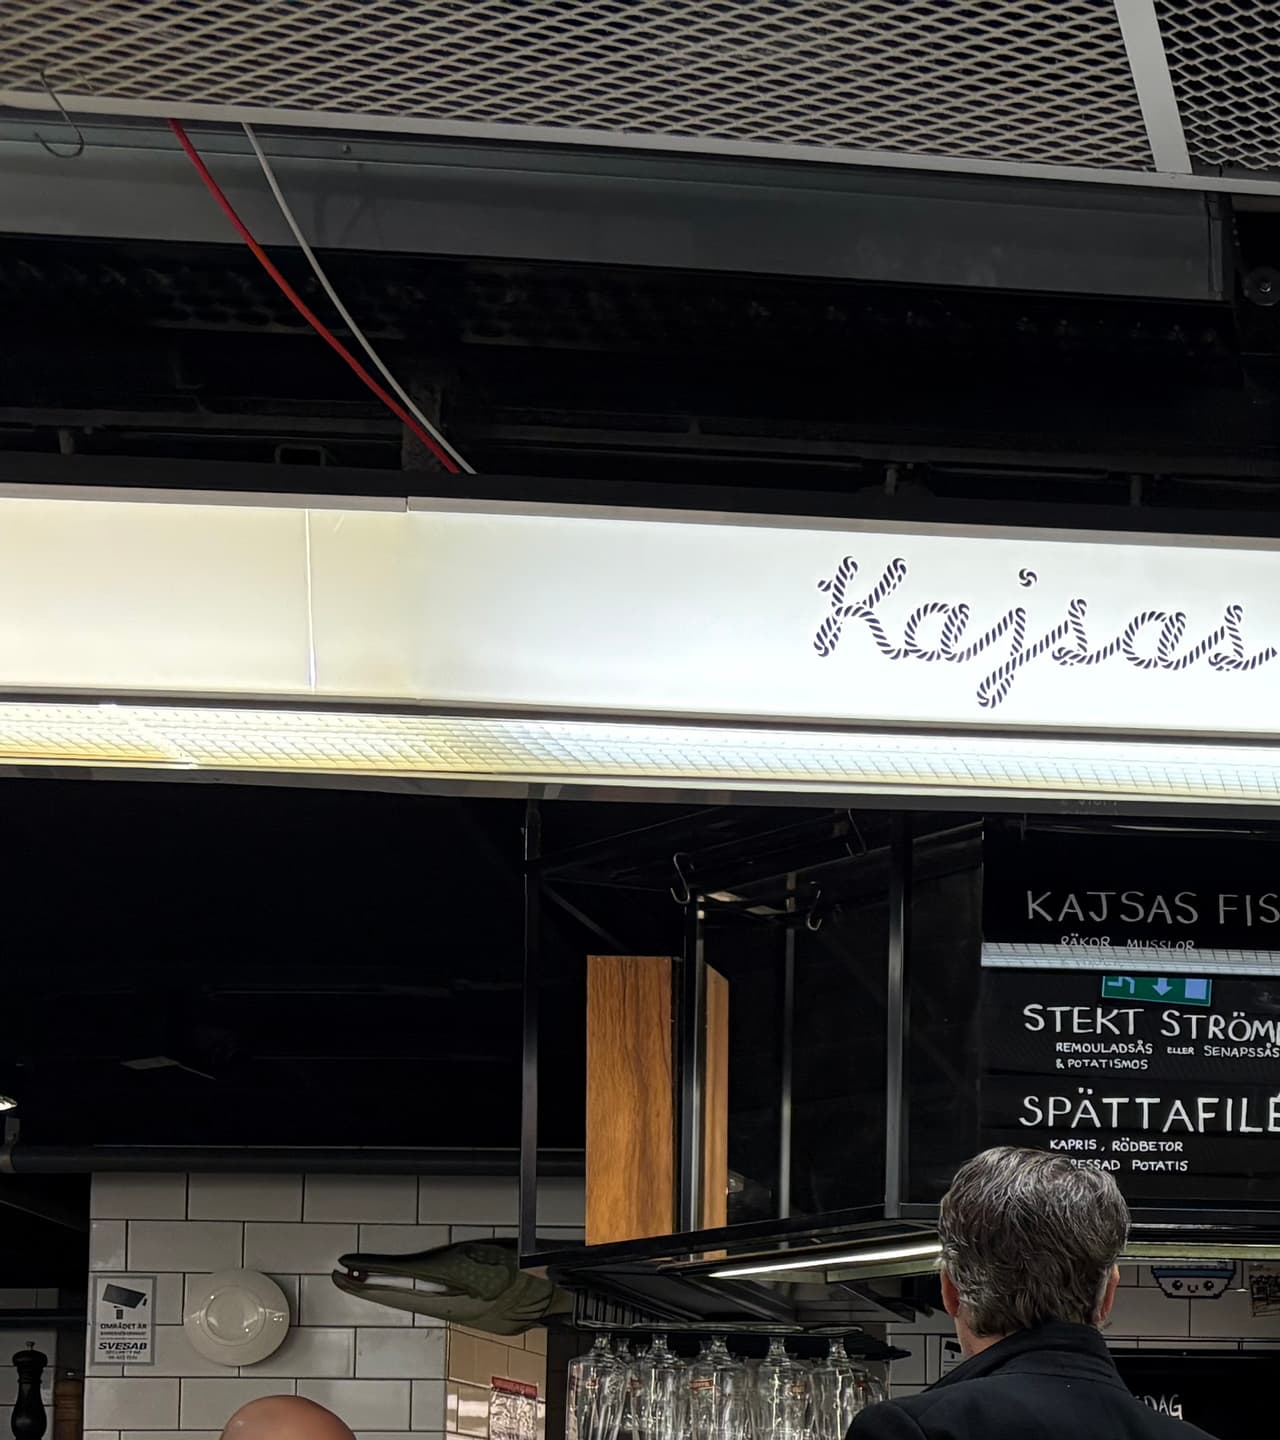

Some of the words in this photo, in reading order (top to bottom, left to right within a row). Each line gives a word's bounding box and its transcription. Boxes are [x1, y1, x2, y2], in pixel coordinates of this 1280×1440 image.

[813, 555, 1278, 709] Kajsas
[1026, 890, 1198, 924] KAJSAS
[1023, 1004, 1143, 1036] STEKT
[1056, 1039, 1153, 1054] REMOULADSÅS
[1166, 1045, 1195, 1056] ELLER
[1203, 1043, 1280, 1058] SENAPSSÅS
[1056, 1058, 1064, 1069] &
[1067, 1057, 1149, 1070] POTATISMOS
[1112, 1137, 1183, 1152] RÖDBETOR
[1132, 1159, 1189, 1171] POTATIS
